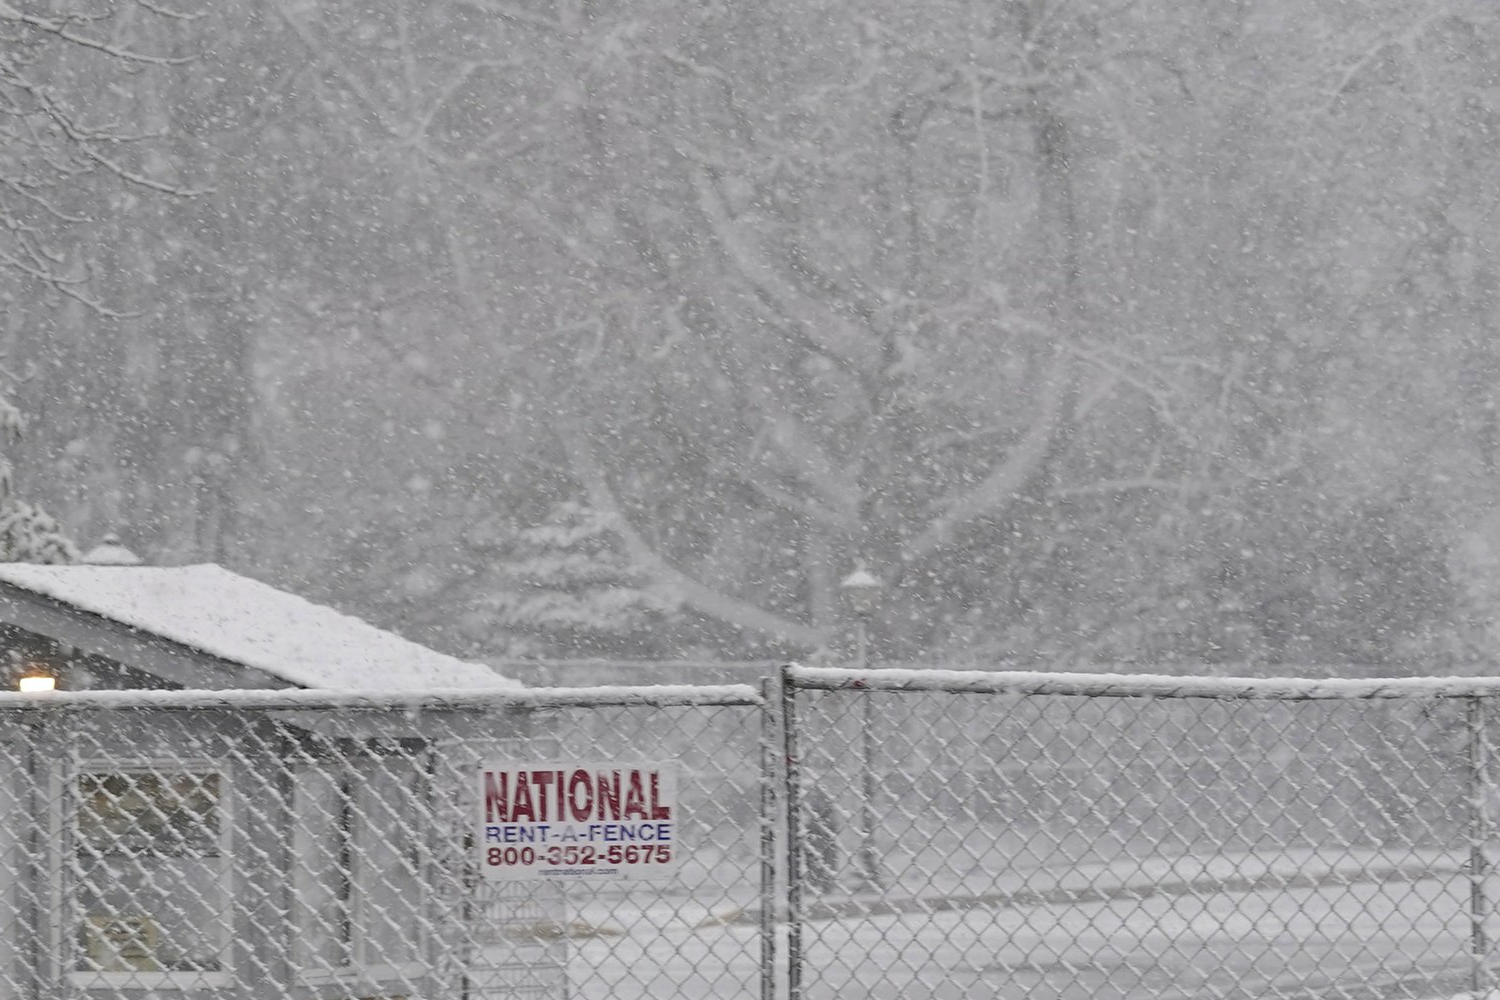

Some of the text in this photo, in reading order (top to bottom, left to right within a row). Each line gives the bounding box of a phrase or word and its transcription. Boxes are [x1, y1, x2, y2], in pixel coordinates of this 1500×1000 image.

[484, 769, 670, 823] NATIONAL
[485, 824, 671, 843] RENT-A-FENCE
[486, 845, 670, 866] 800-352-5675
